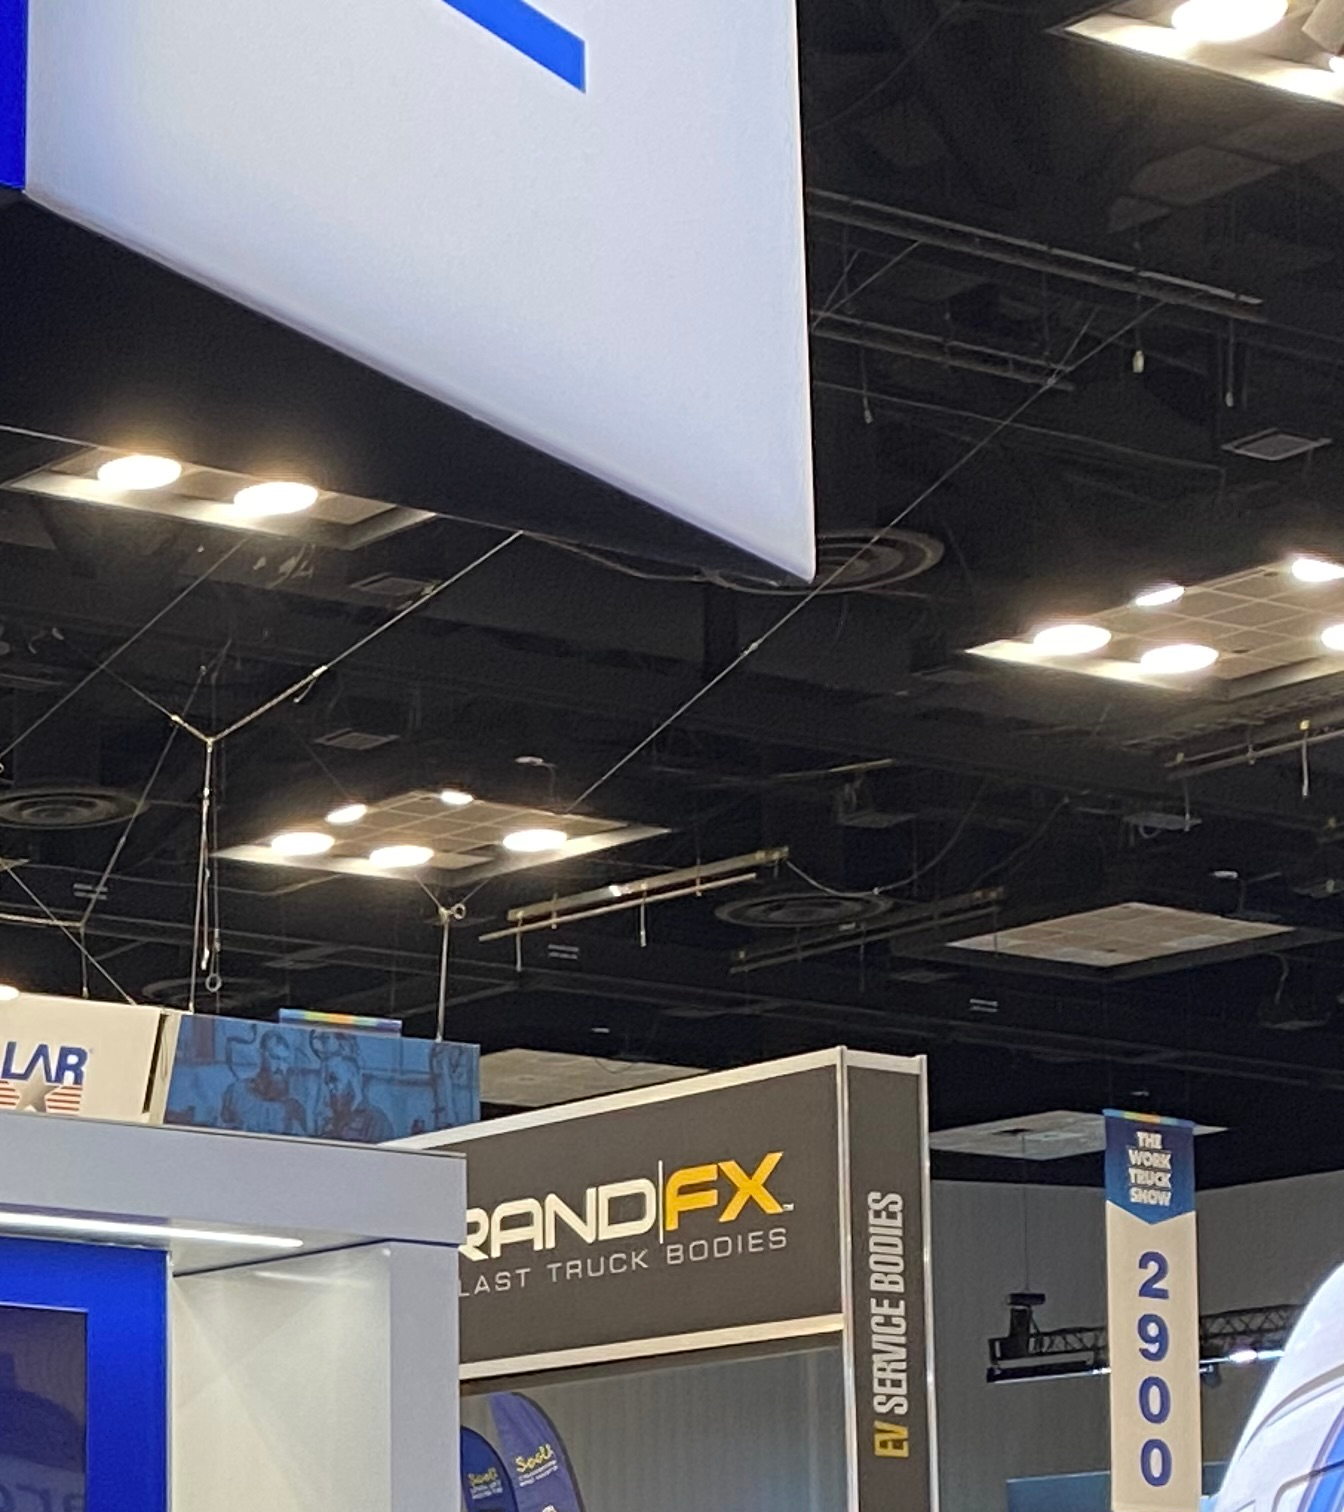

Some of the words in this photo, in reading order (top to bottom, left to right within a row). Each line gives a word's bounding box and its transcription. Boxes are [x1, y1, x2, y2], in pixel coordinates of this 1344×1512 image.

[547, 1250, 649, 1283] TRUCK
[667, 1228, 787, 1266] BODIES
[868, 1191, 905, 1293] BODIES
[871, 1298, 908, 1415] SERVICE
[874, 1421, 909, 1458] EV
